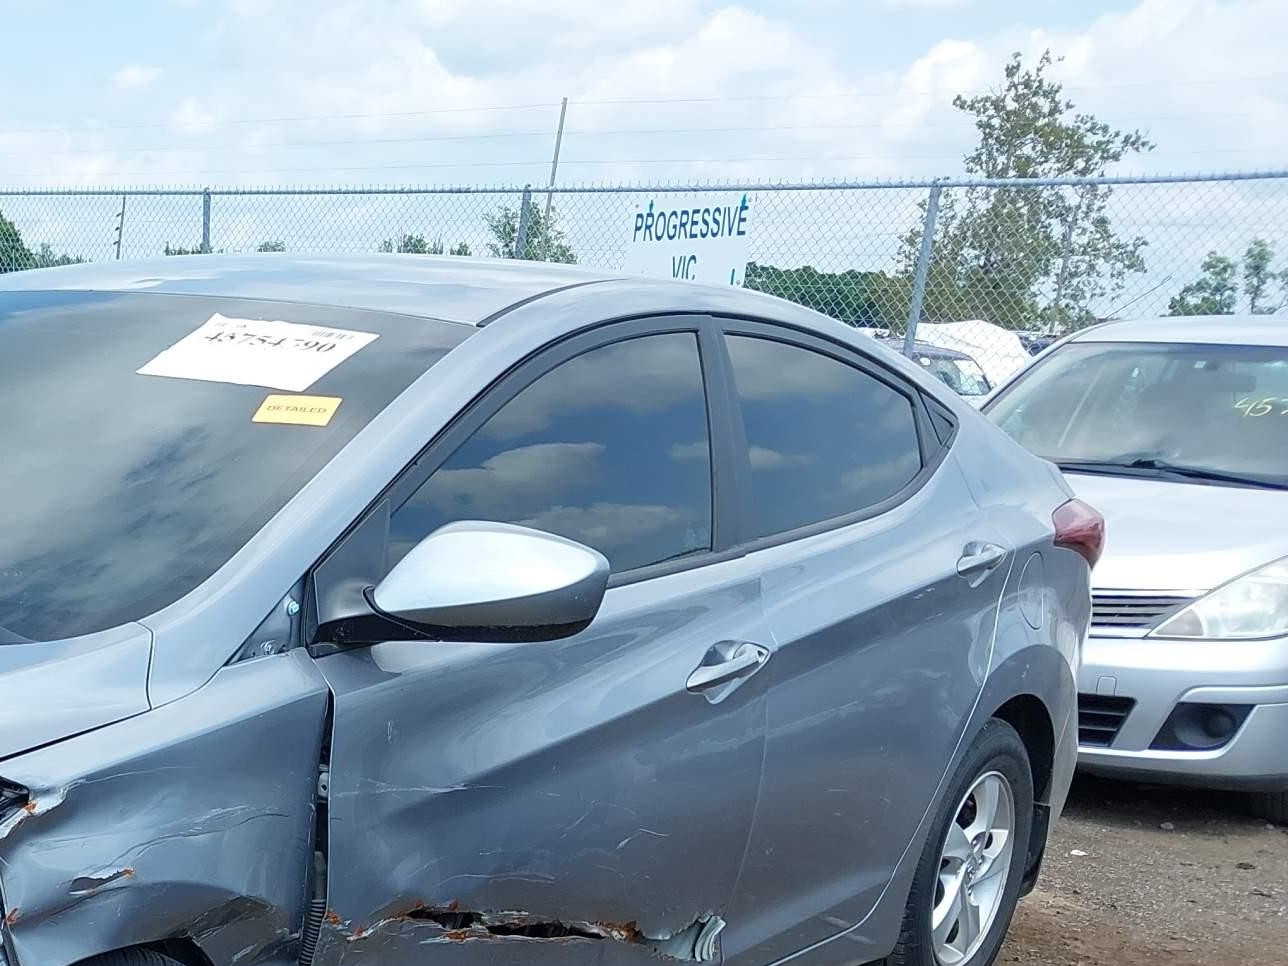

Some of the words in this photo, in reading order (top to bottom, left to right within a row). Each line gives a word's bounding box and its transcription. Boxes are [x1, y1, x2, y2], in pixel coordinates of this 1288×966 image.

[632, 204, 749, 242] PROGRESSIVE
[671, 254, 697, 281] VIC
[266, 404, 328, 415] DETAILED
